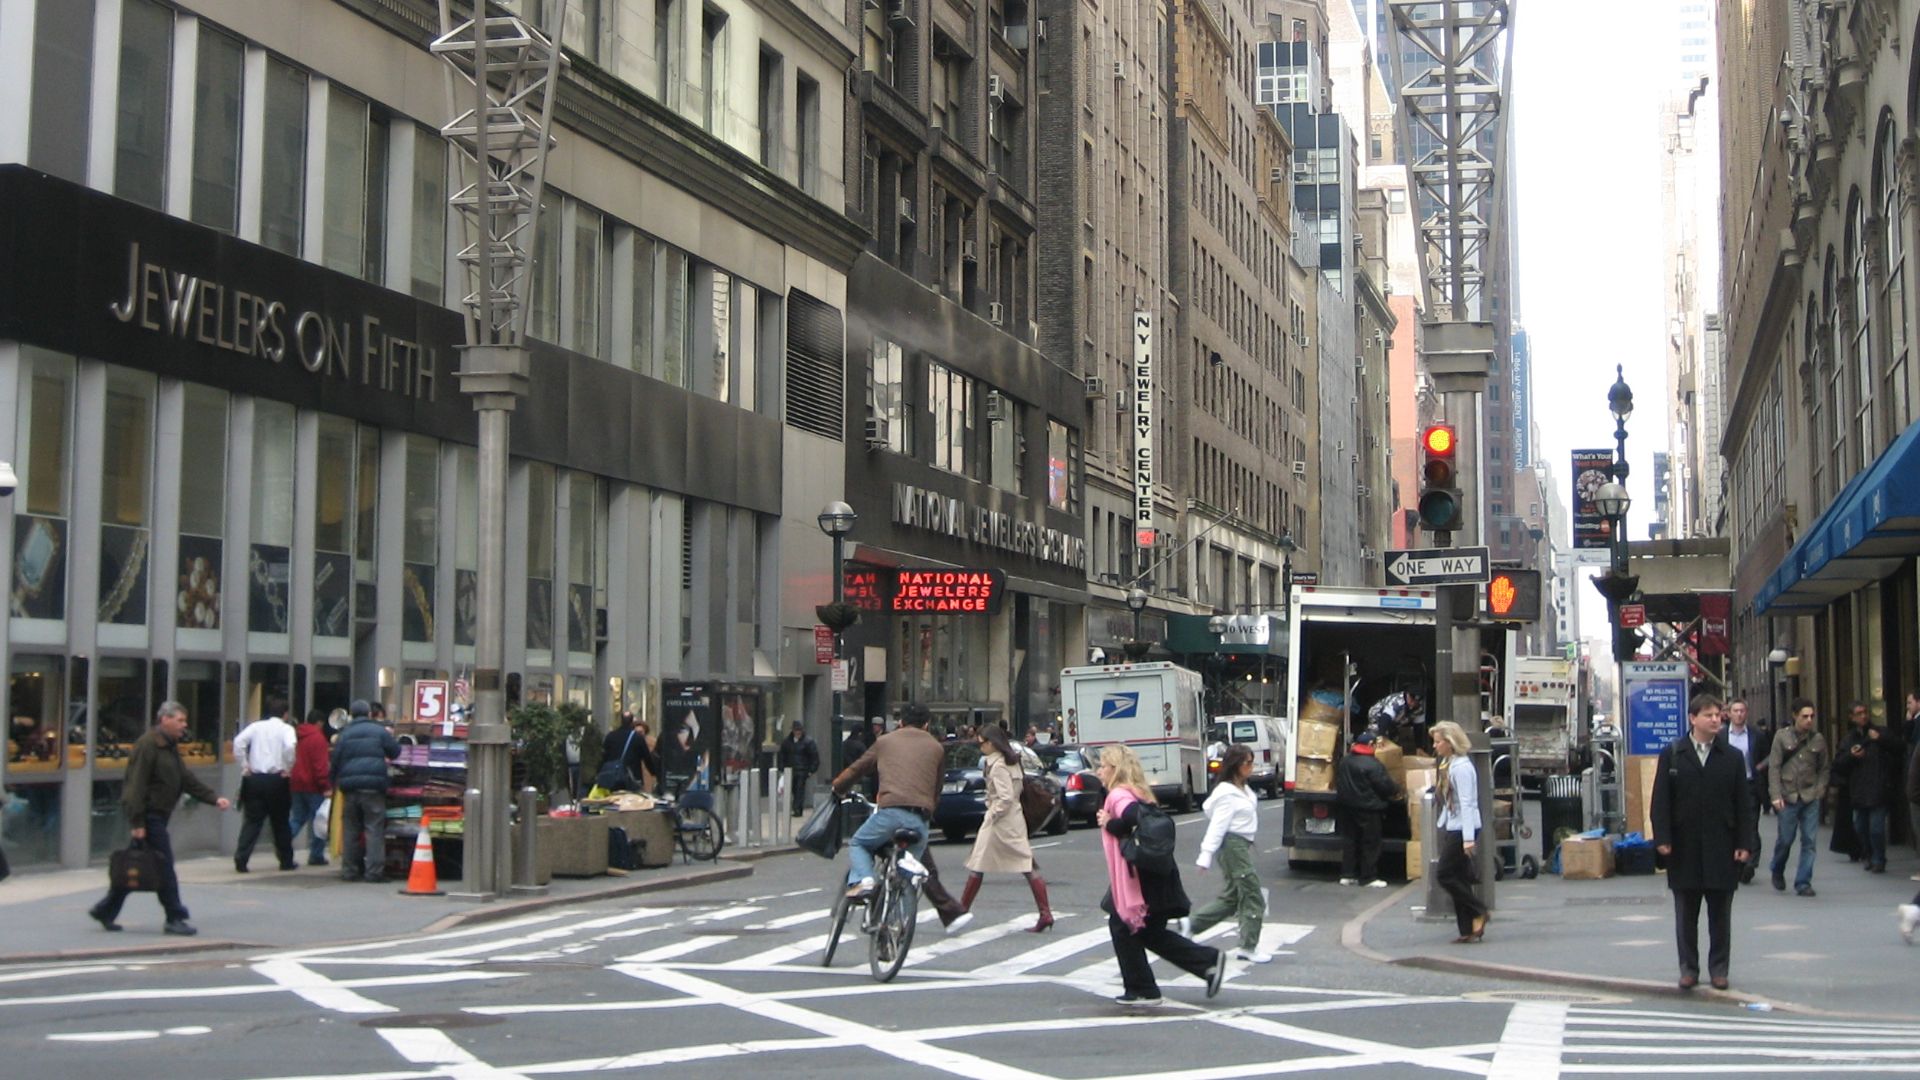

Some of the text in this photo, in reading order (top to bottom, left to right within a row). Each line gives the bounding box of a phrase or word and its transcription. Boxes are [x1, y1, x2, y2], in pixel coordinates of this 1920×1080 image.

[110, 242, 436, 402] JEWELERS ON FIFTH
[1137, 354, 1150, 439] JEWELRY
[1137, 447, 1150, 521] CENTER
[894, 483, 968, 539] NATIONAL
[974, 505, 1036, 557] JEWELERS
[1396, 558, 1475, 575] ONE WAY
[899, 571, 992, 585] NATIONAL
[897, 585, 990, 598] JEWELERS
[893, 598, 985, 611] EXCHANGE
[1237, 625, 1266, 634] WEST
